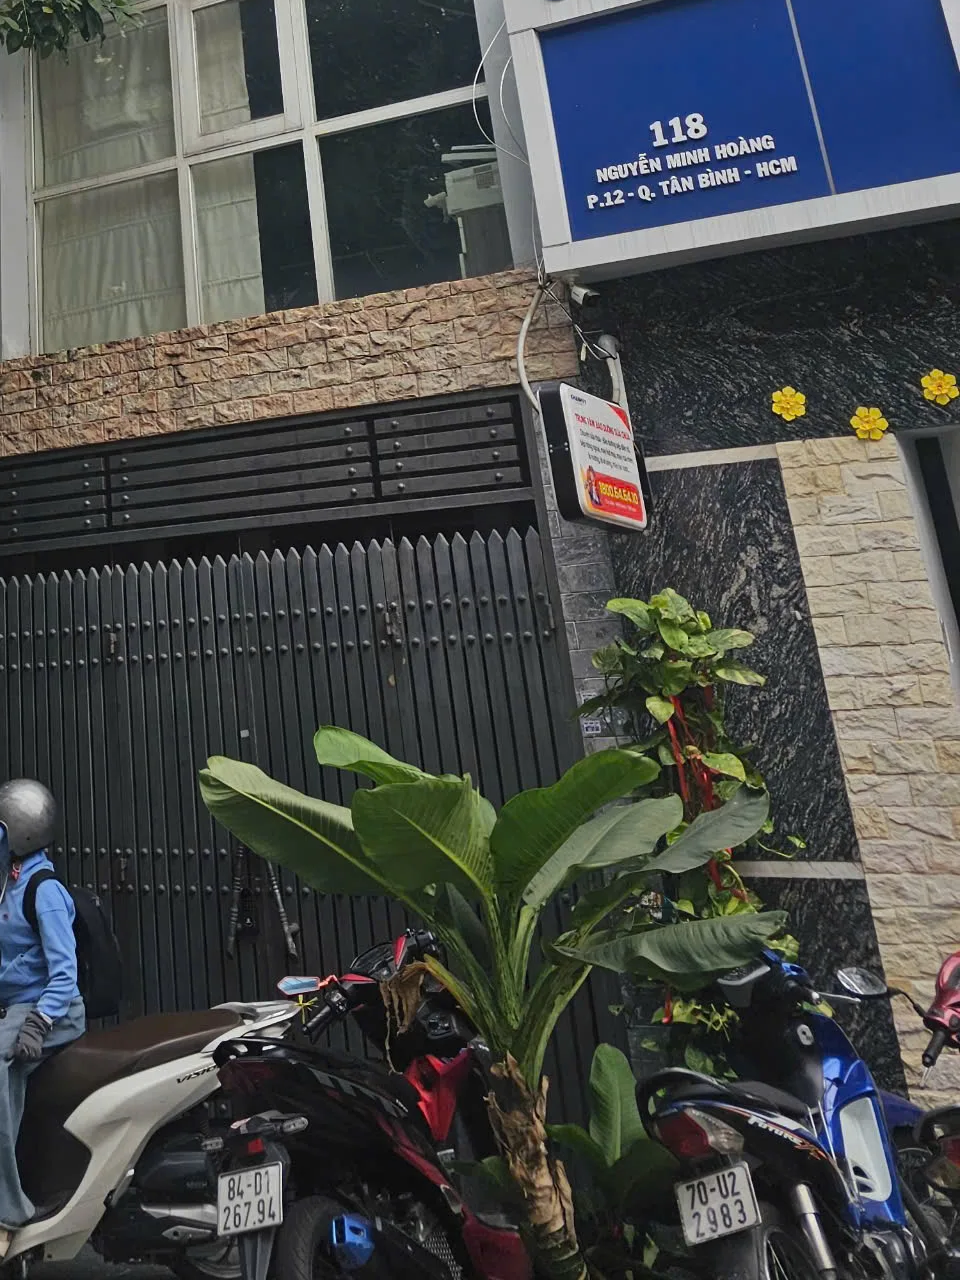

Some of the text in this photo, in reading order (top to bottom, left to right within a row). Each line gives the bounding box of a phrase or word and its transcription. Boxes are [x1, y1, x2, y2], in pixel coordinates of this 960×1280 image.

[649, 113, 708, 148] 118
[596, 134, 775, 184] NGUYỄN MINH HOÀNG
[587, 189, 625, 209] P.12
[638, 184, 656, 202] Q.
[659, 175, 695, 195] TÂN
[698, 166, 740, 189] BÌNH
[757, 156, 797, 177] HCM
[176, 1065, 219, 1084] VISIO
[748, 1115, 803, 1146] FUTURE
[227, 1171, 271, 1201] 84-D1
[686, 1172, 740, 1210] 70-U2
[223, 1197, 276, 1232] 267.94
[692, 1200, 746, 1238] 2983
